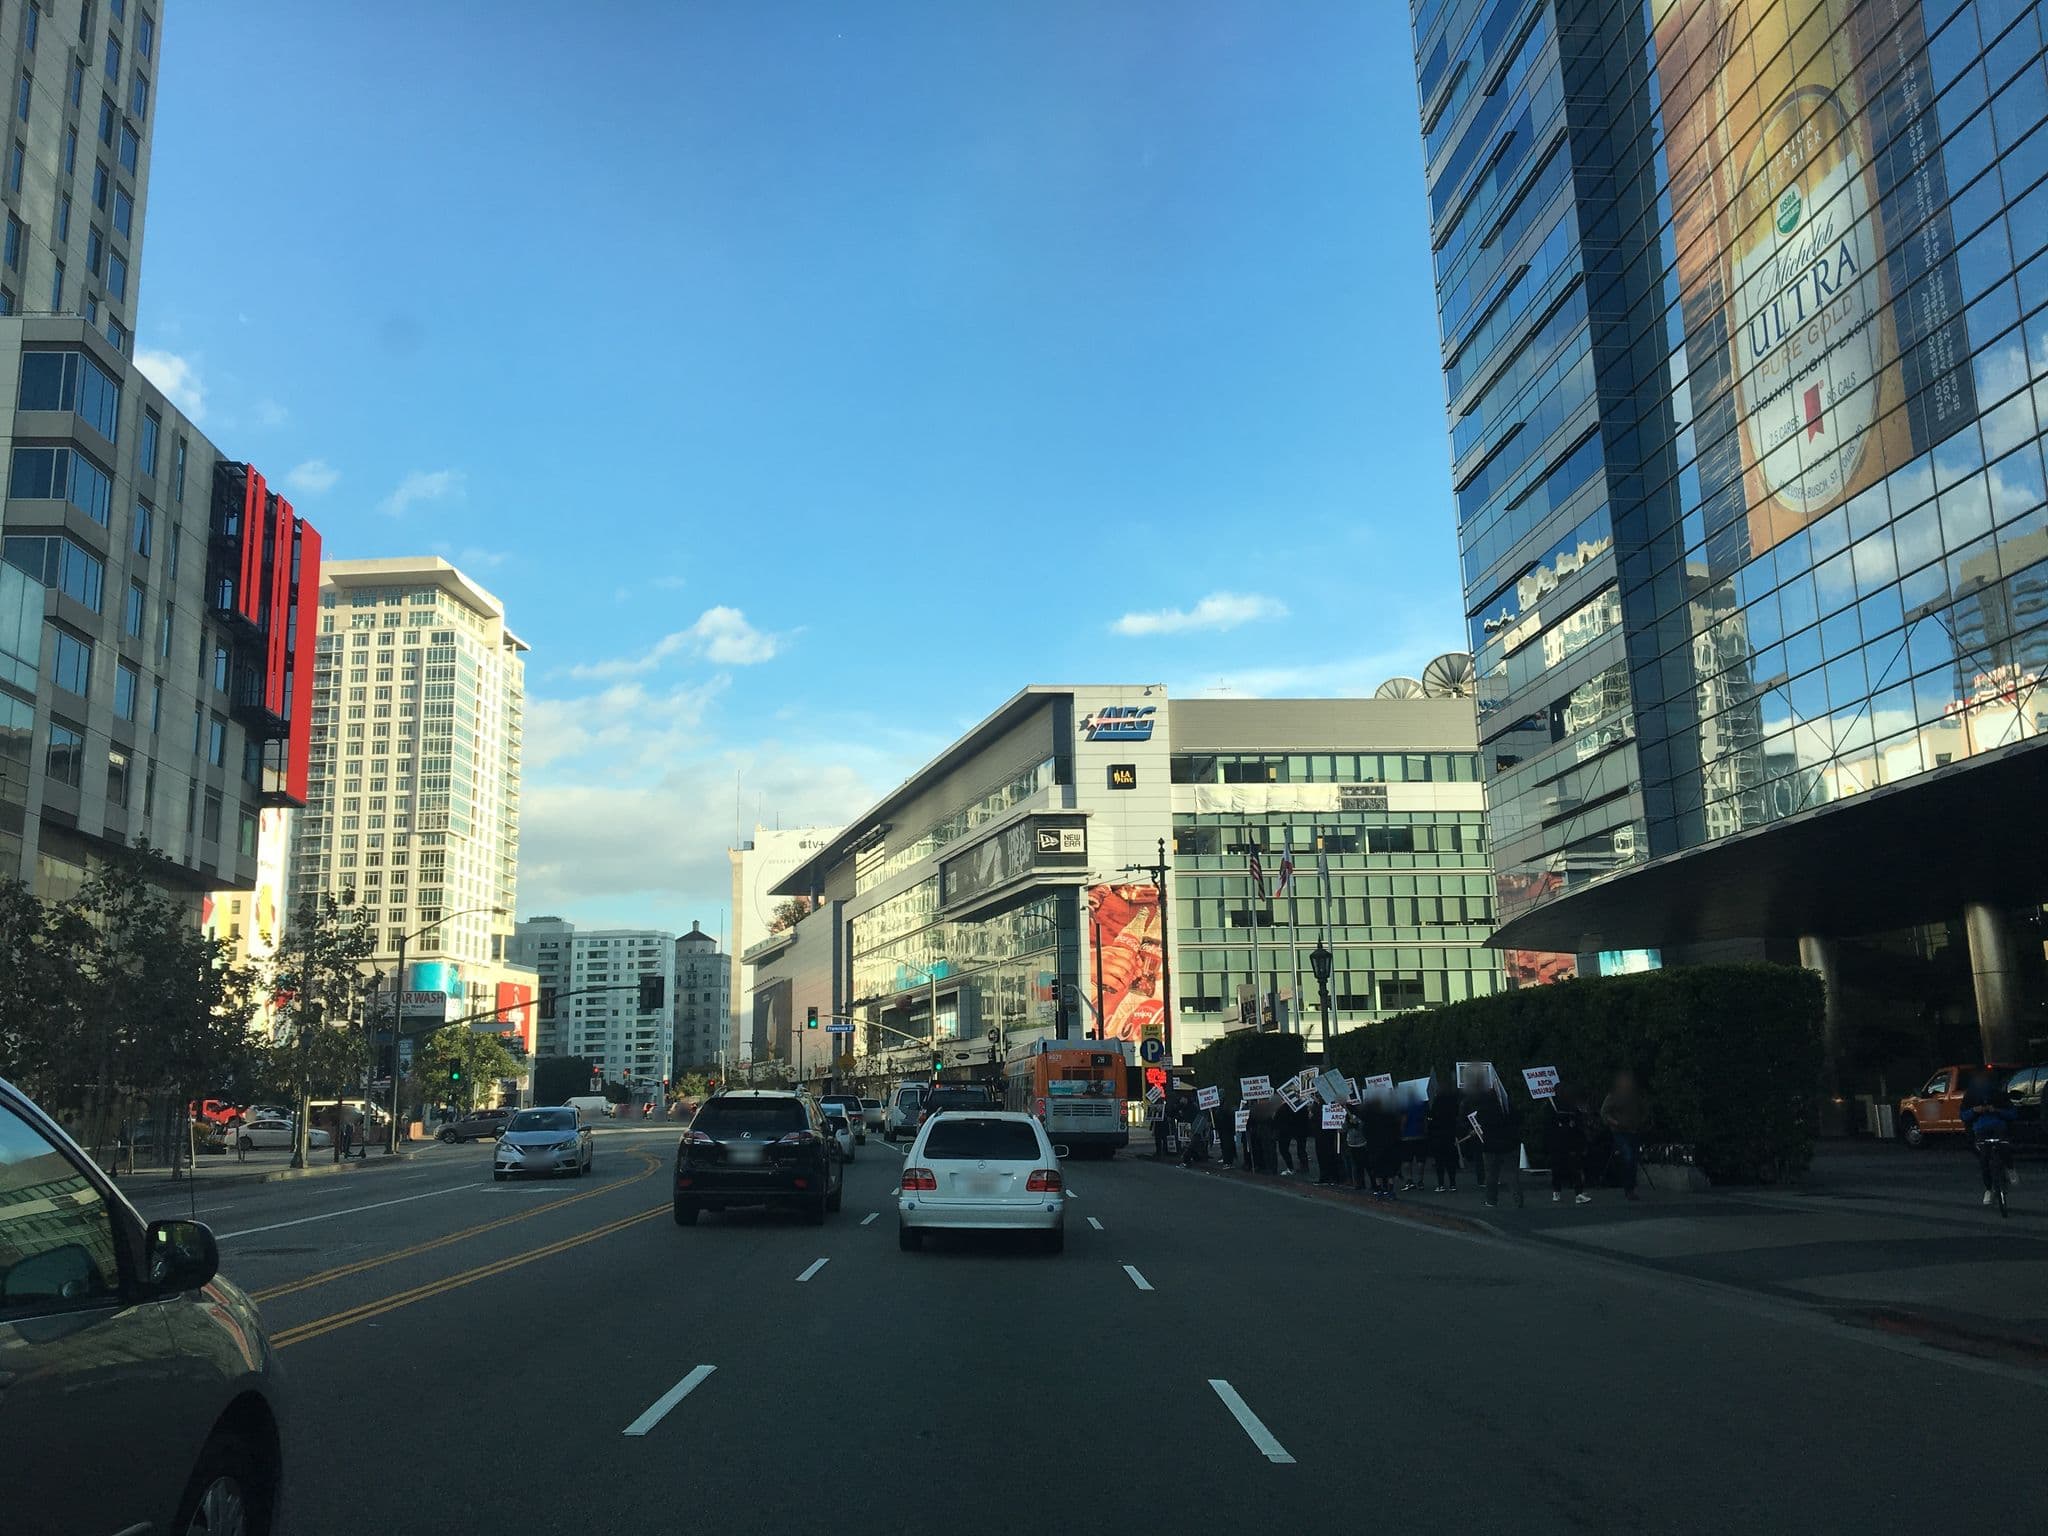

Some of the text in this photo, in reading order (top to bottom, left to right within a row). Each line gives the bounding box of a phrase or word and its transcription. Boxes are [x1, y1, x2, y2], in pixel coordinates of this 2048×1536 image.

[1750, 240, 1859, 357] ULTRA
[1761, 294, 1854, 382] PURE GOLD
[1094, 705, 1157, 741] AEG
[1120, 770, 1131, 778] LA
[1063, 833, 1081, 841] NEW
[414, 992, 444, 1004] WASH
[1146, 1040, 1159, 1061] P
[1527, 1071, 1547, 1079] SHAME
